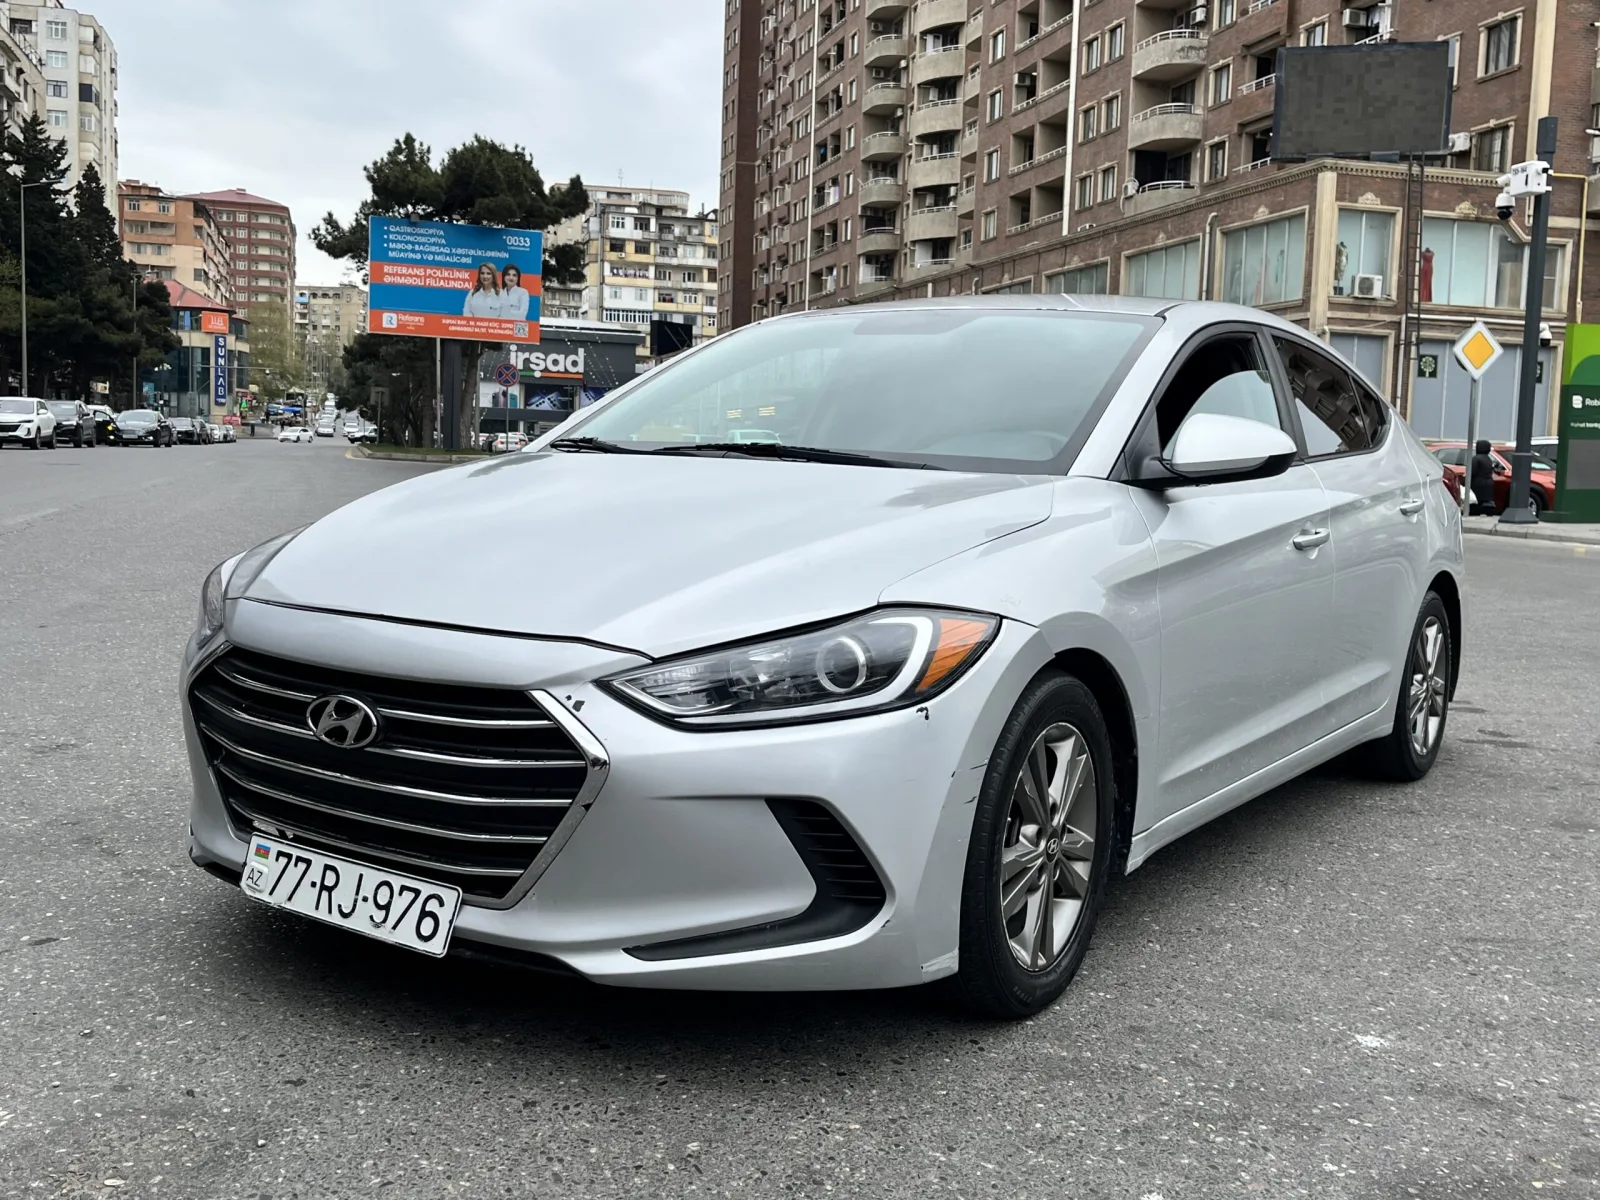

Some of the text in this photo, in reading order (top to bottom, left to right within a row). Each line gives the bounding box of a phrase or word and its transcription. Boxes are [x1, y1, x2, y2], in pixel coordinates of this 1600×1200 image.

[389, 233, 446, 245] KOLONOSKOPİYA
[383, 265, 470, 280] REFERANS POLİKLİNİK
[383, 275, 424, 286] ƏHMƏDLİ
[246, 867, 263, 887] AZ
